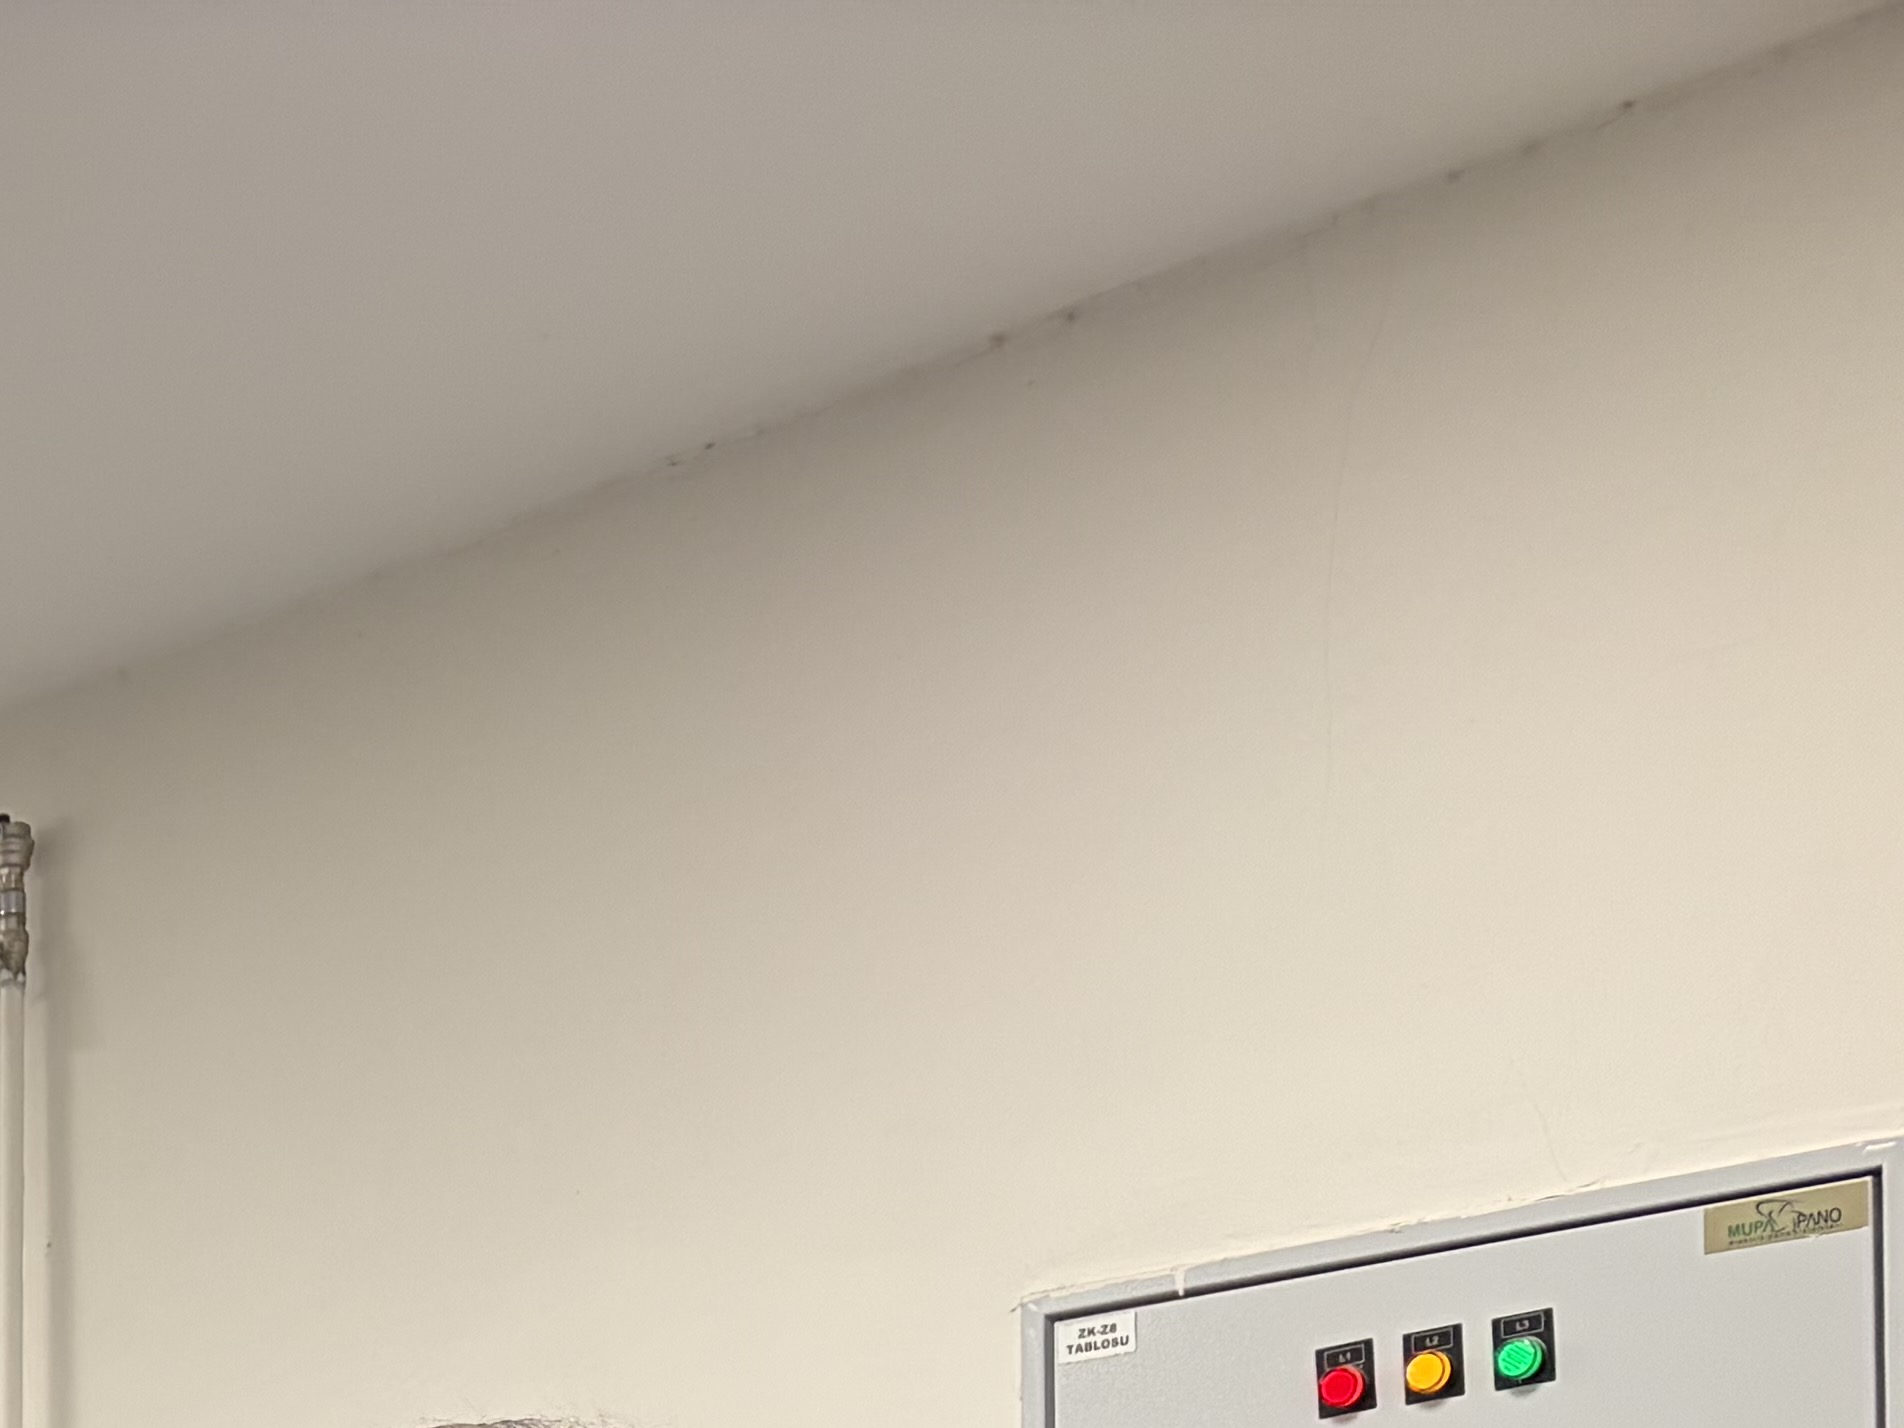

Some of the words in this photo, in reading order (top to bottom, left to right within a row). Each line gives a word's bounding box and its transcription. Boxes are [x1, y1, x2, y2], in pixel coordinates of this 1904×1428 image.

[1797, 1207, 1842, 1229] PANO
[1515, 1319, 1530, 1332] L3
[1066, 1334, 1130, 1355] TABLOSU
[1424, 1335, 1440, 1347] L2
